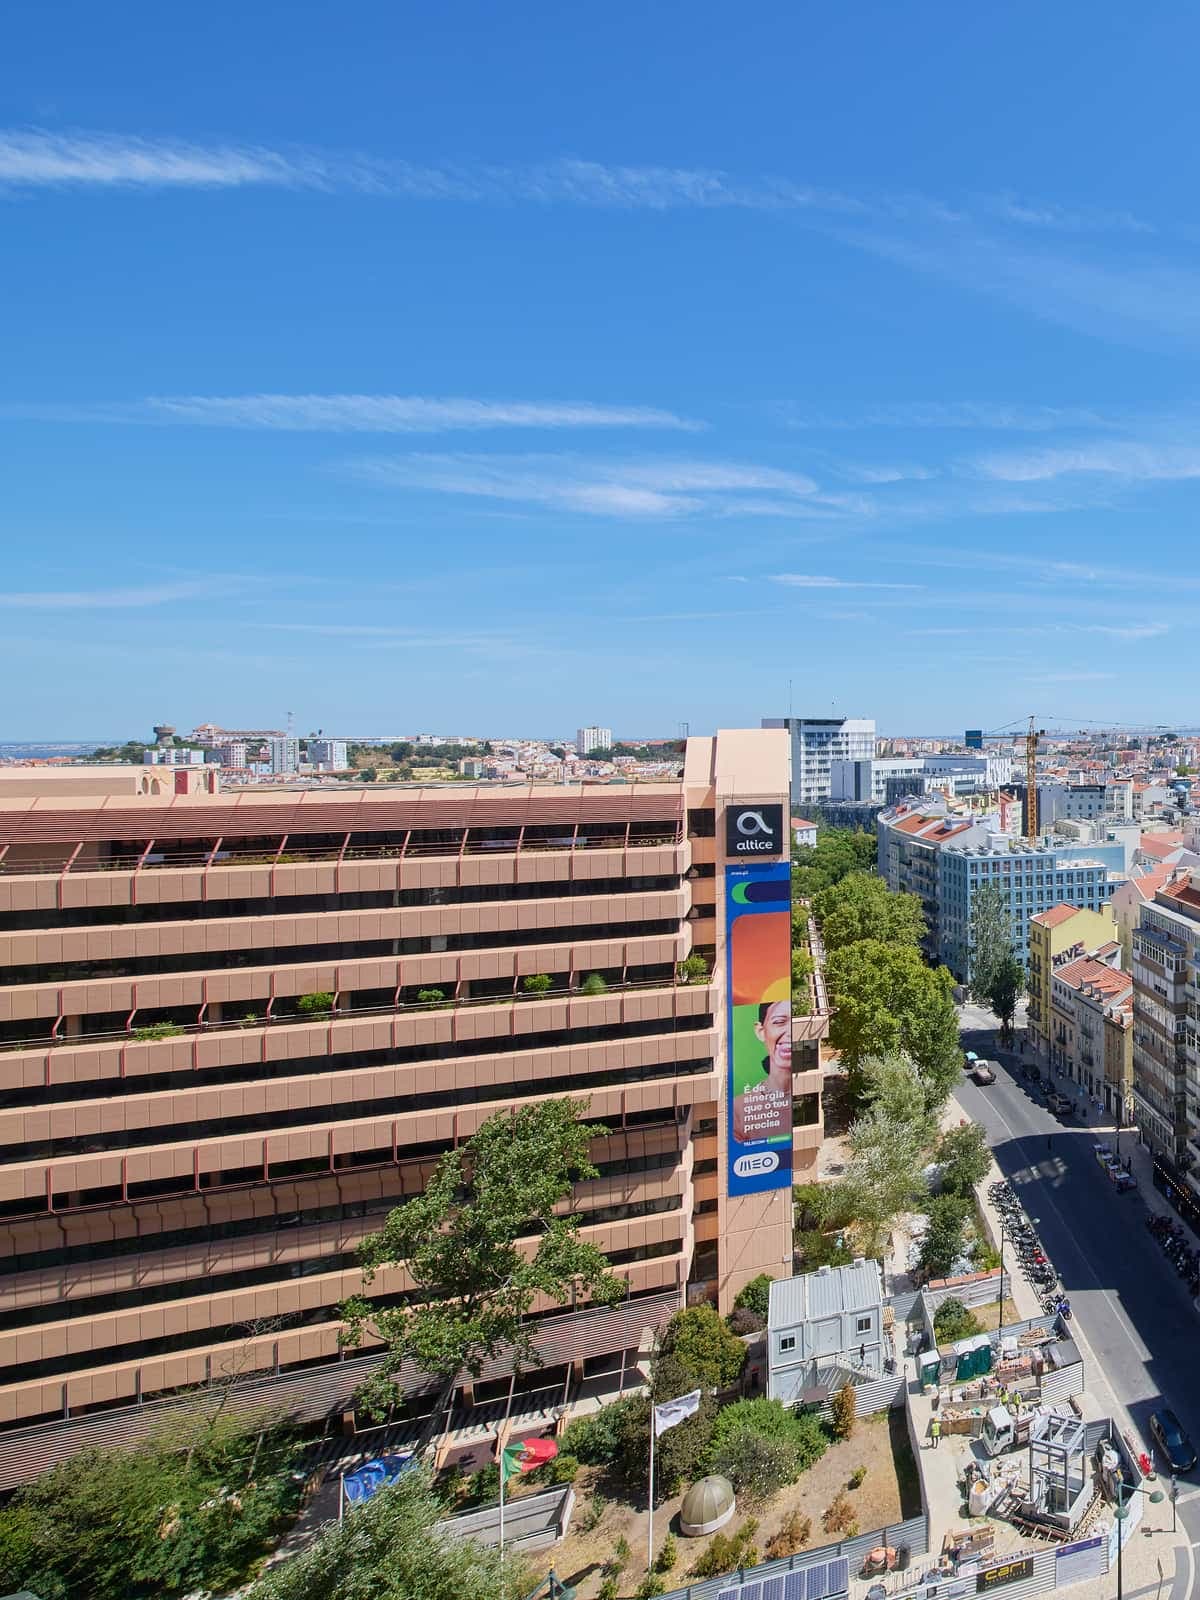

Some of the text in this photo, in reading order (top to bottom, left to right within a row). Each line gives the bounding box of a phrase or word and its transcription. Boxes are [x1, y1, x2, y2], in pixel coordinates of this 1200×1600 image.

[736, 839, 774, 850] altice
[744, 1090, 785, 1103] sinergia
[744, 1104, 763, 1114] que
[744, 1110, 780, 1121] mundo
[744, 1120, 780, 1133] precisa
